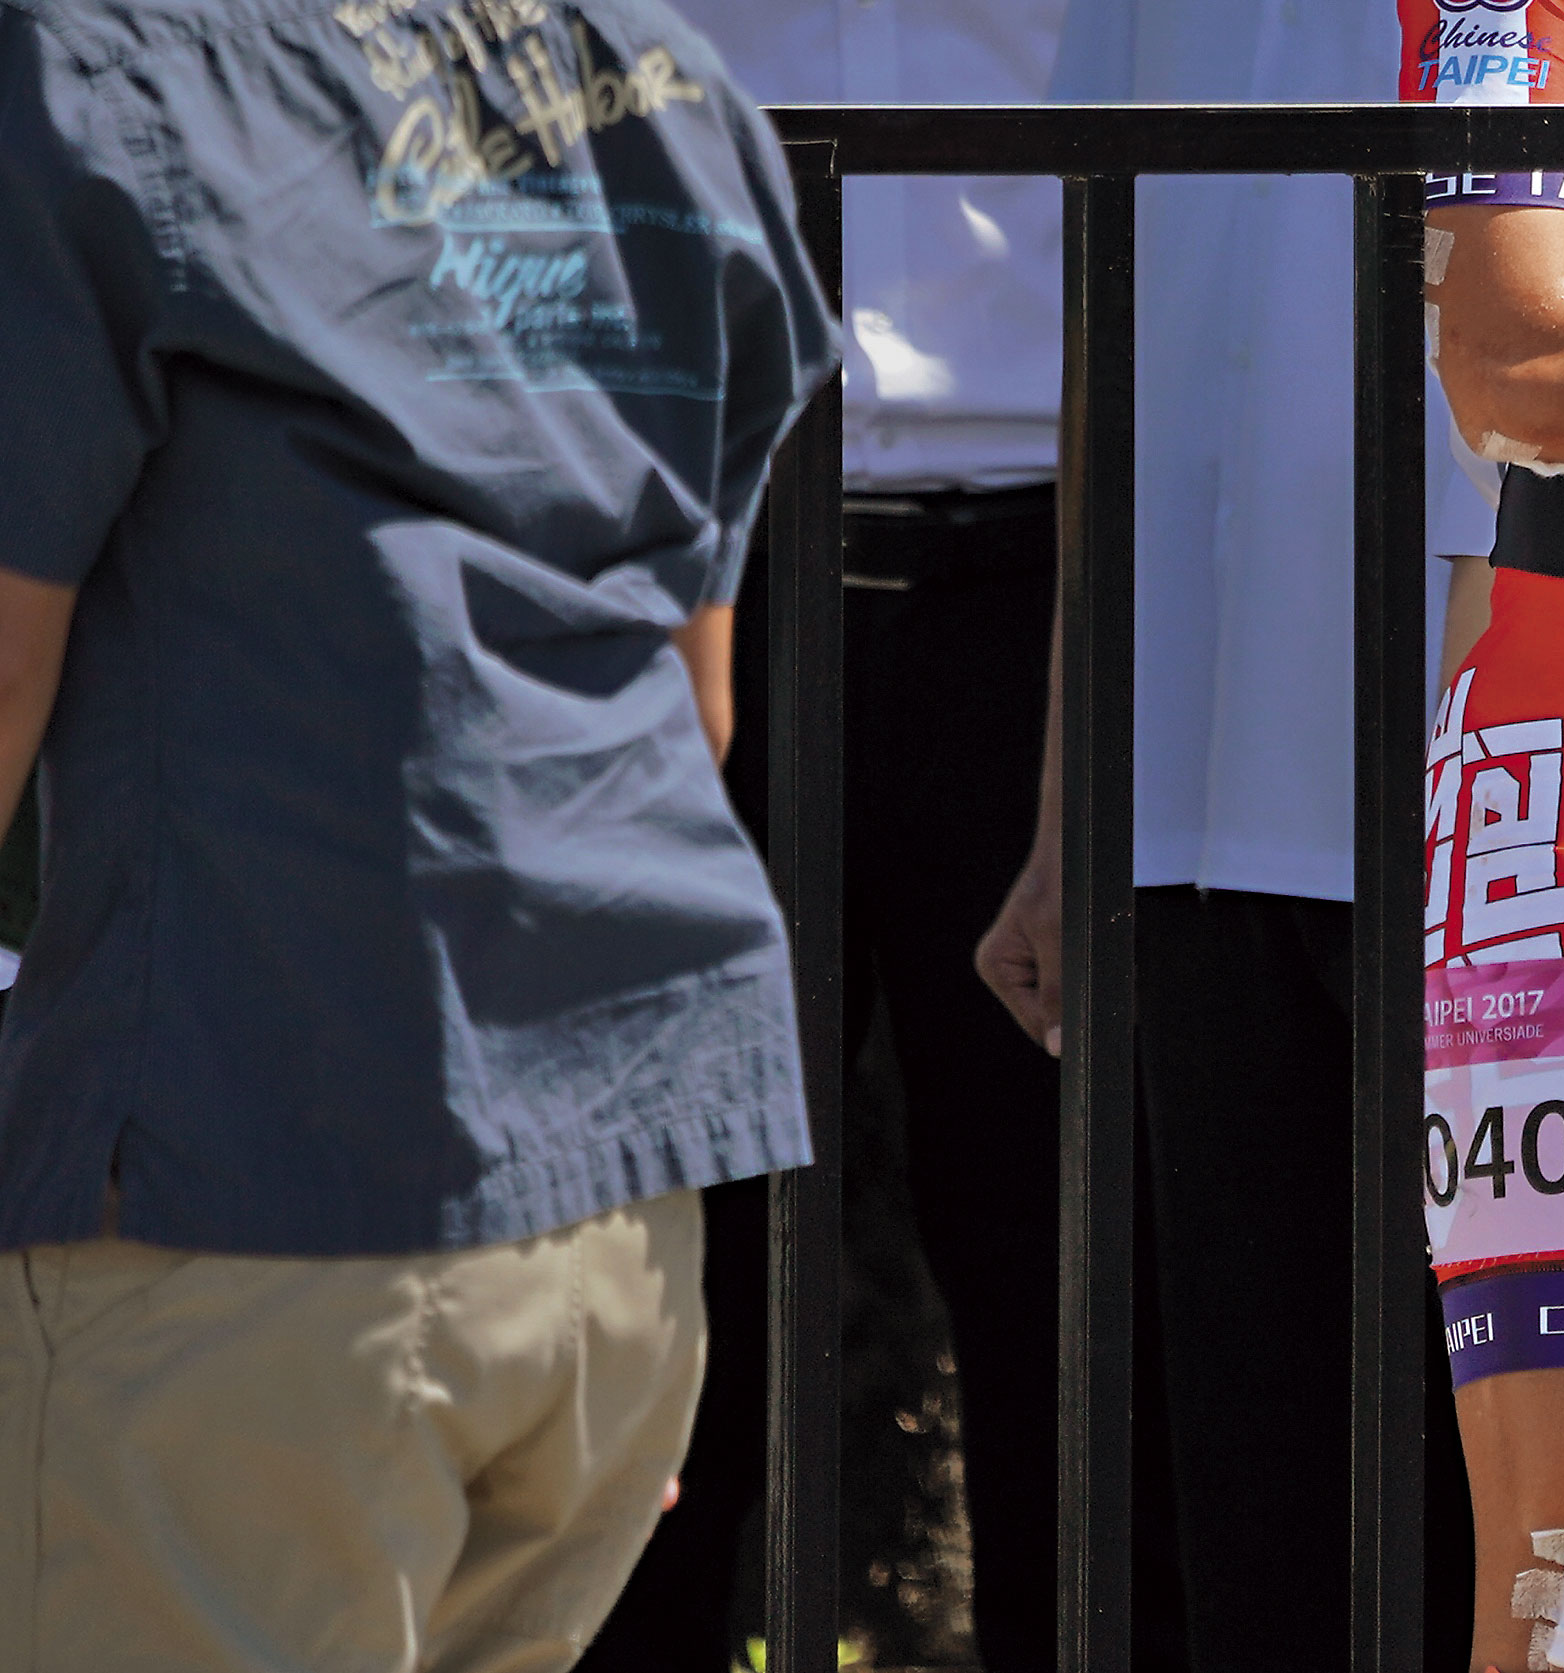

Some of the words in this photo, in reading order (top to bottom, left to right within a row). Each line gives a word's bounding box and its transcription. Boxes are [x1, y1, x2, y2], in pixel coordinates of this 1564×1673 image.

[1419, 17, 1553, 61] Chinese
[1417, 54, 1550, 91] TAIPEI
[1482, 989, 1544, 1021] 2017
[1456, 1023, 1544, 1046] UNIVERSIADE
